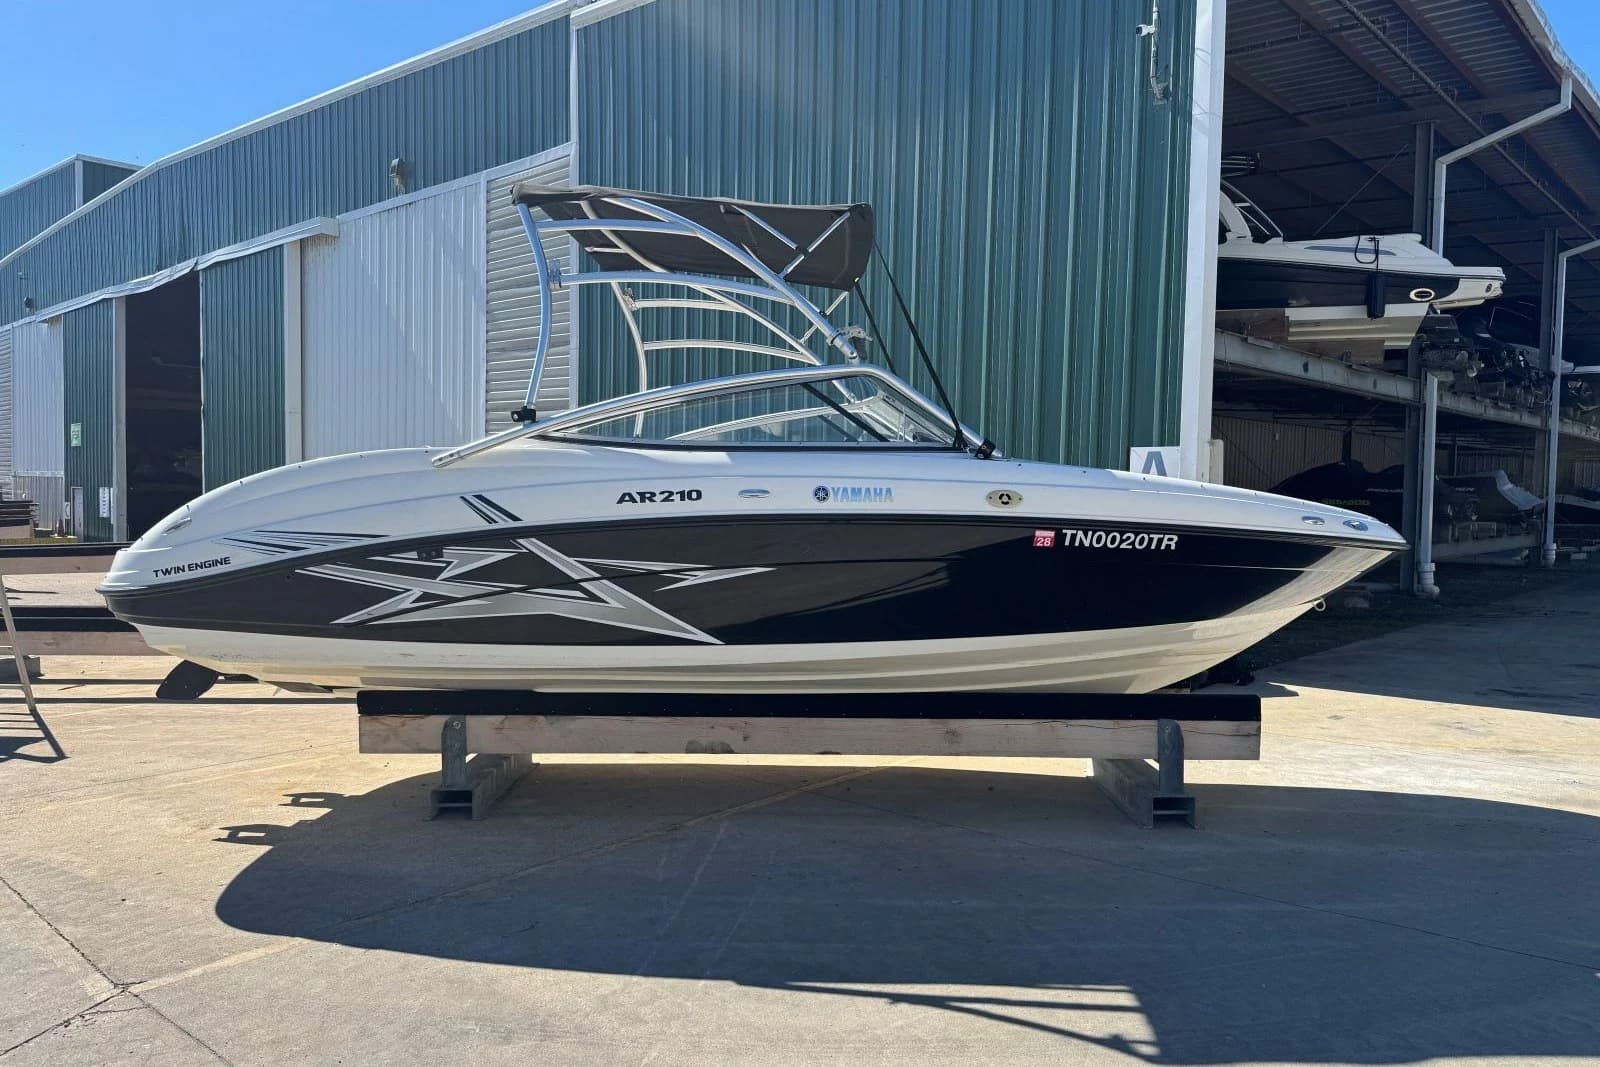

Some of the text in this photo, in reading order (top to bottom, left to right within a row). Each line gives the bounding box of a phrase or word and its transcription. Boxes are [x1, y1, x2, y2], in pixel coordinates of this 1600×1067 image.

[616, 489, 702, 504] AR210
[831, 487, 893, 503] YAMAHA
[1062, 529, 1178, 551] TN0020TR
[153, 556, 231, 578] TWIN ENGINE
